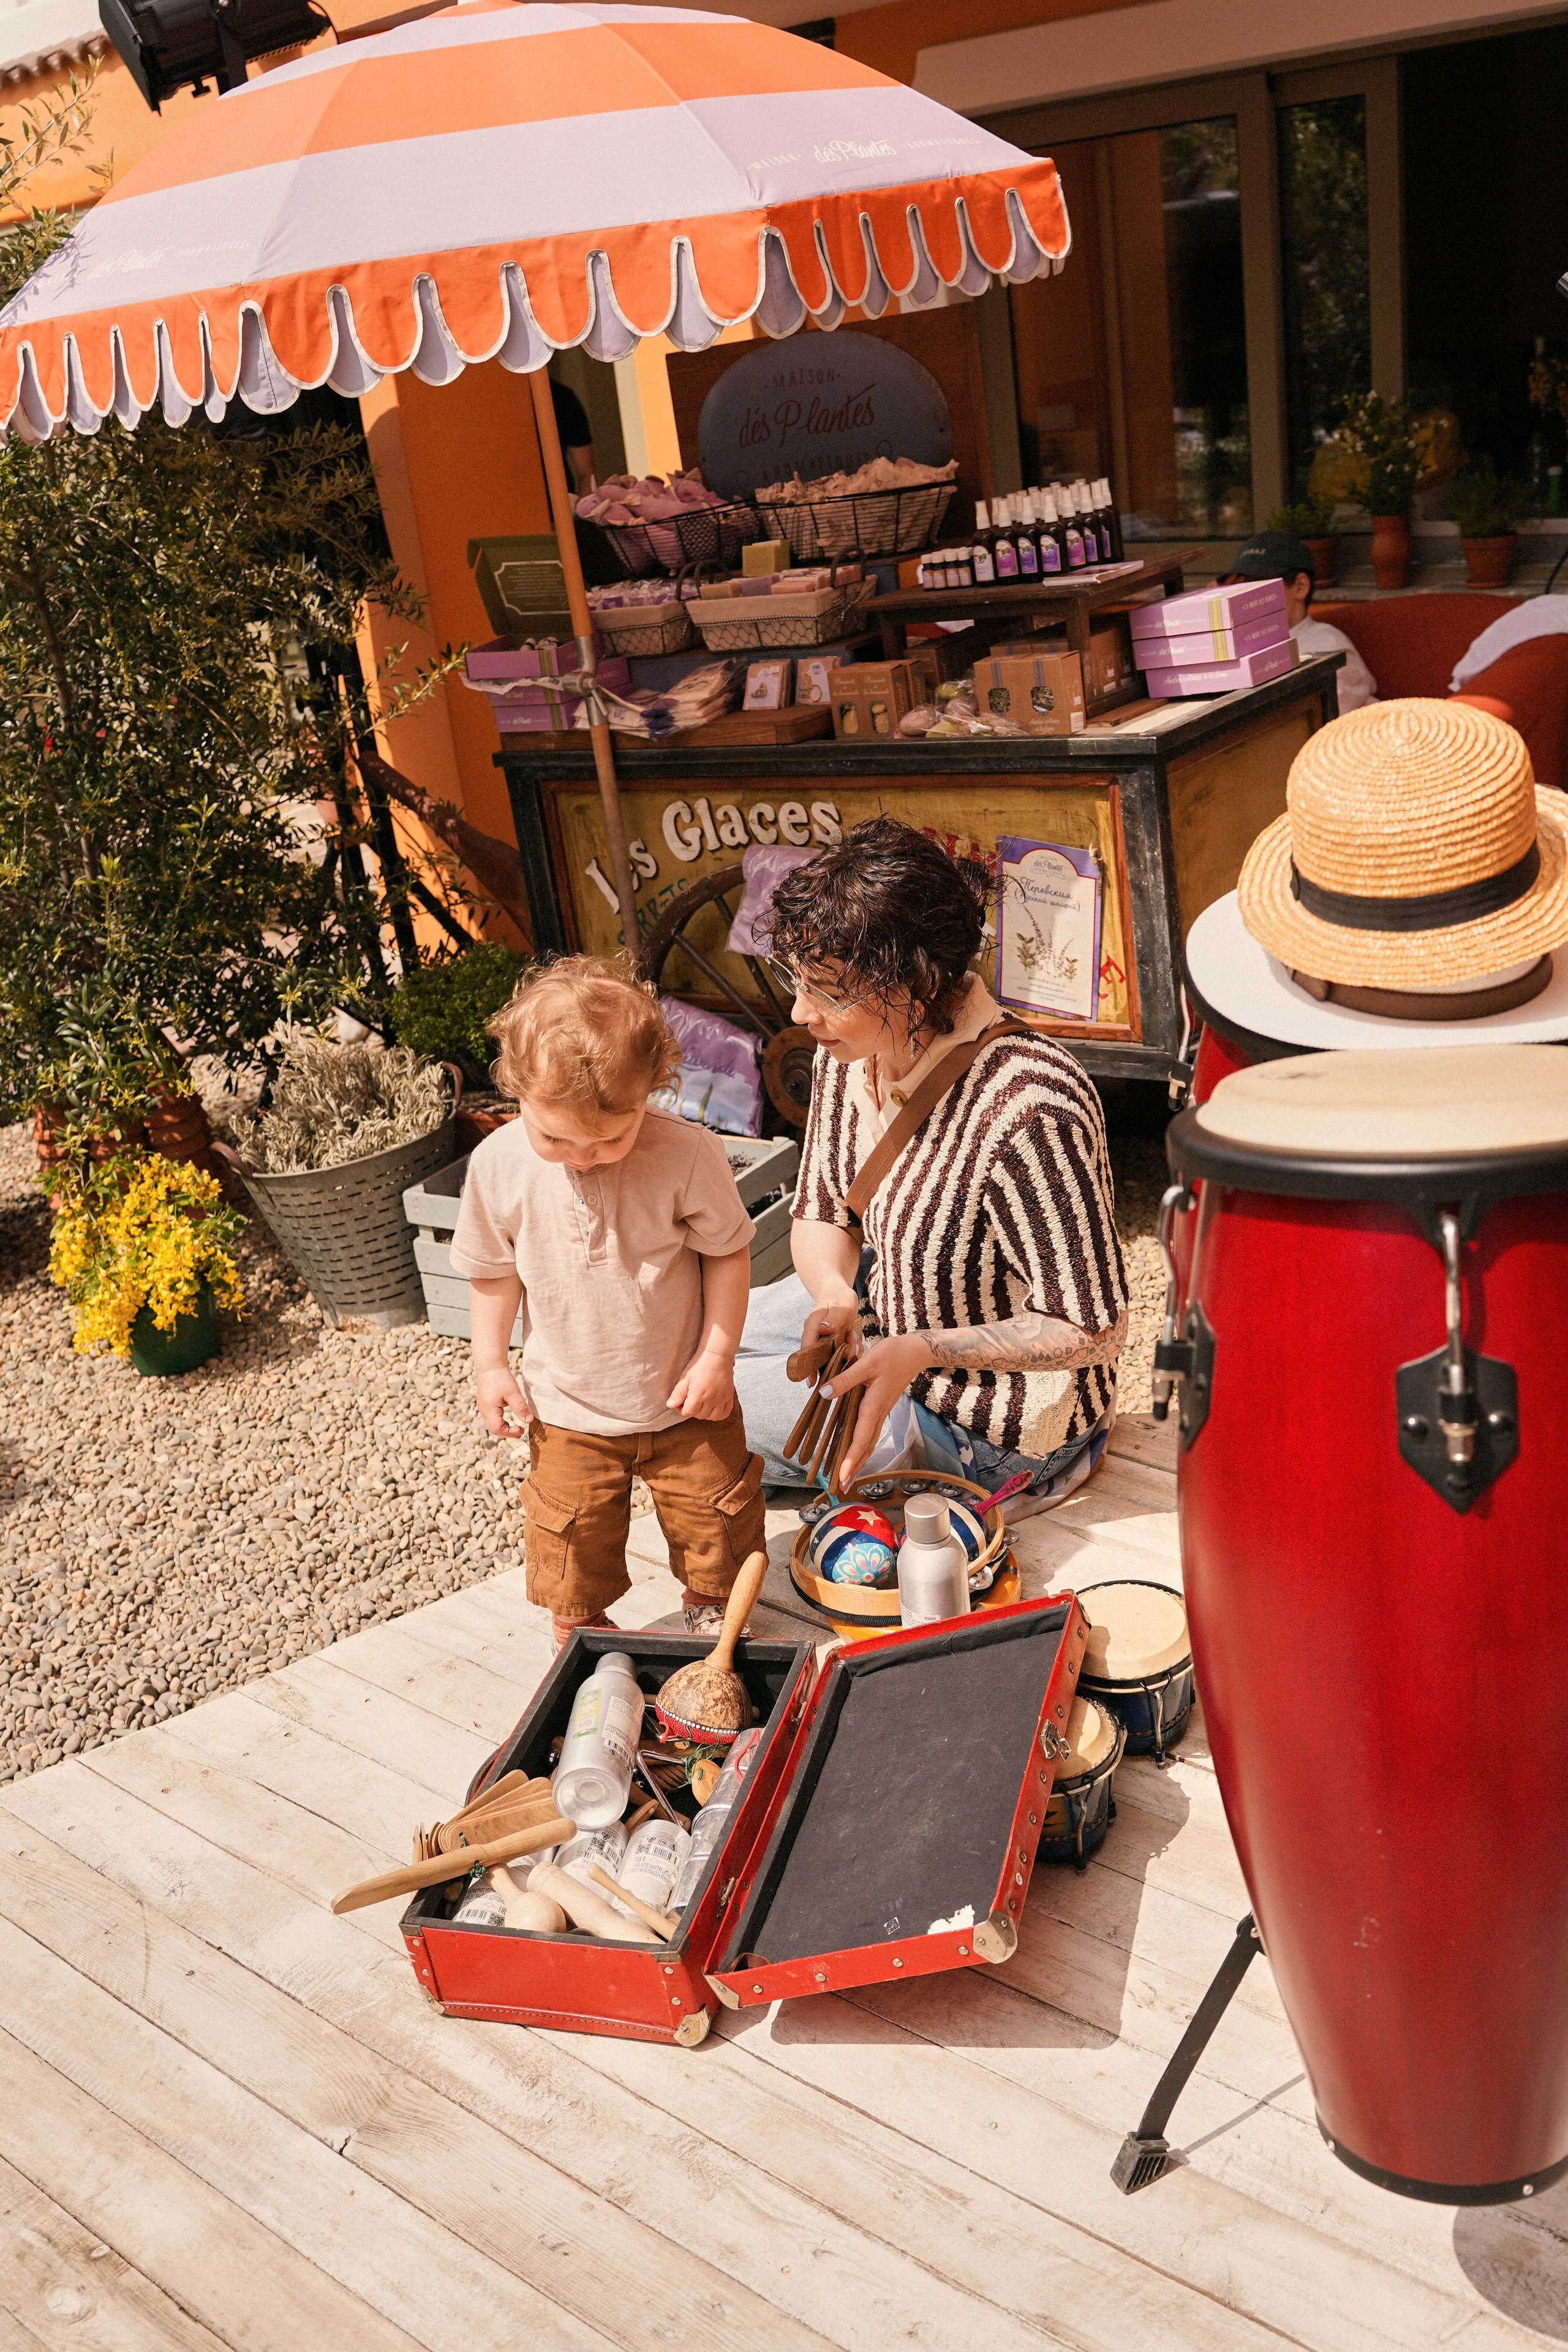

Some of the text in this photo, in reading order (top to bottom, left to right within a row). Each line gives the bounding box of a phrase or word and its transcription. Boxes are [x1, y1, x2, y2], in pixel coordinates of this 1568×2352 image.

[831, 139, 897, 161] Plantes
[772, 368, 834, 388] MAISON
[773, 383, 876, 448] Plantes
[584, 837, 658, 915] Ls
[662, 797, 844, 862] Glaces
[1020, 876, 1073, 900] Перовския
